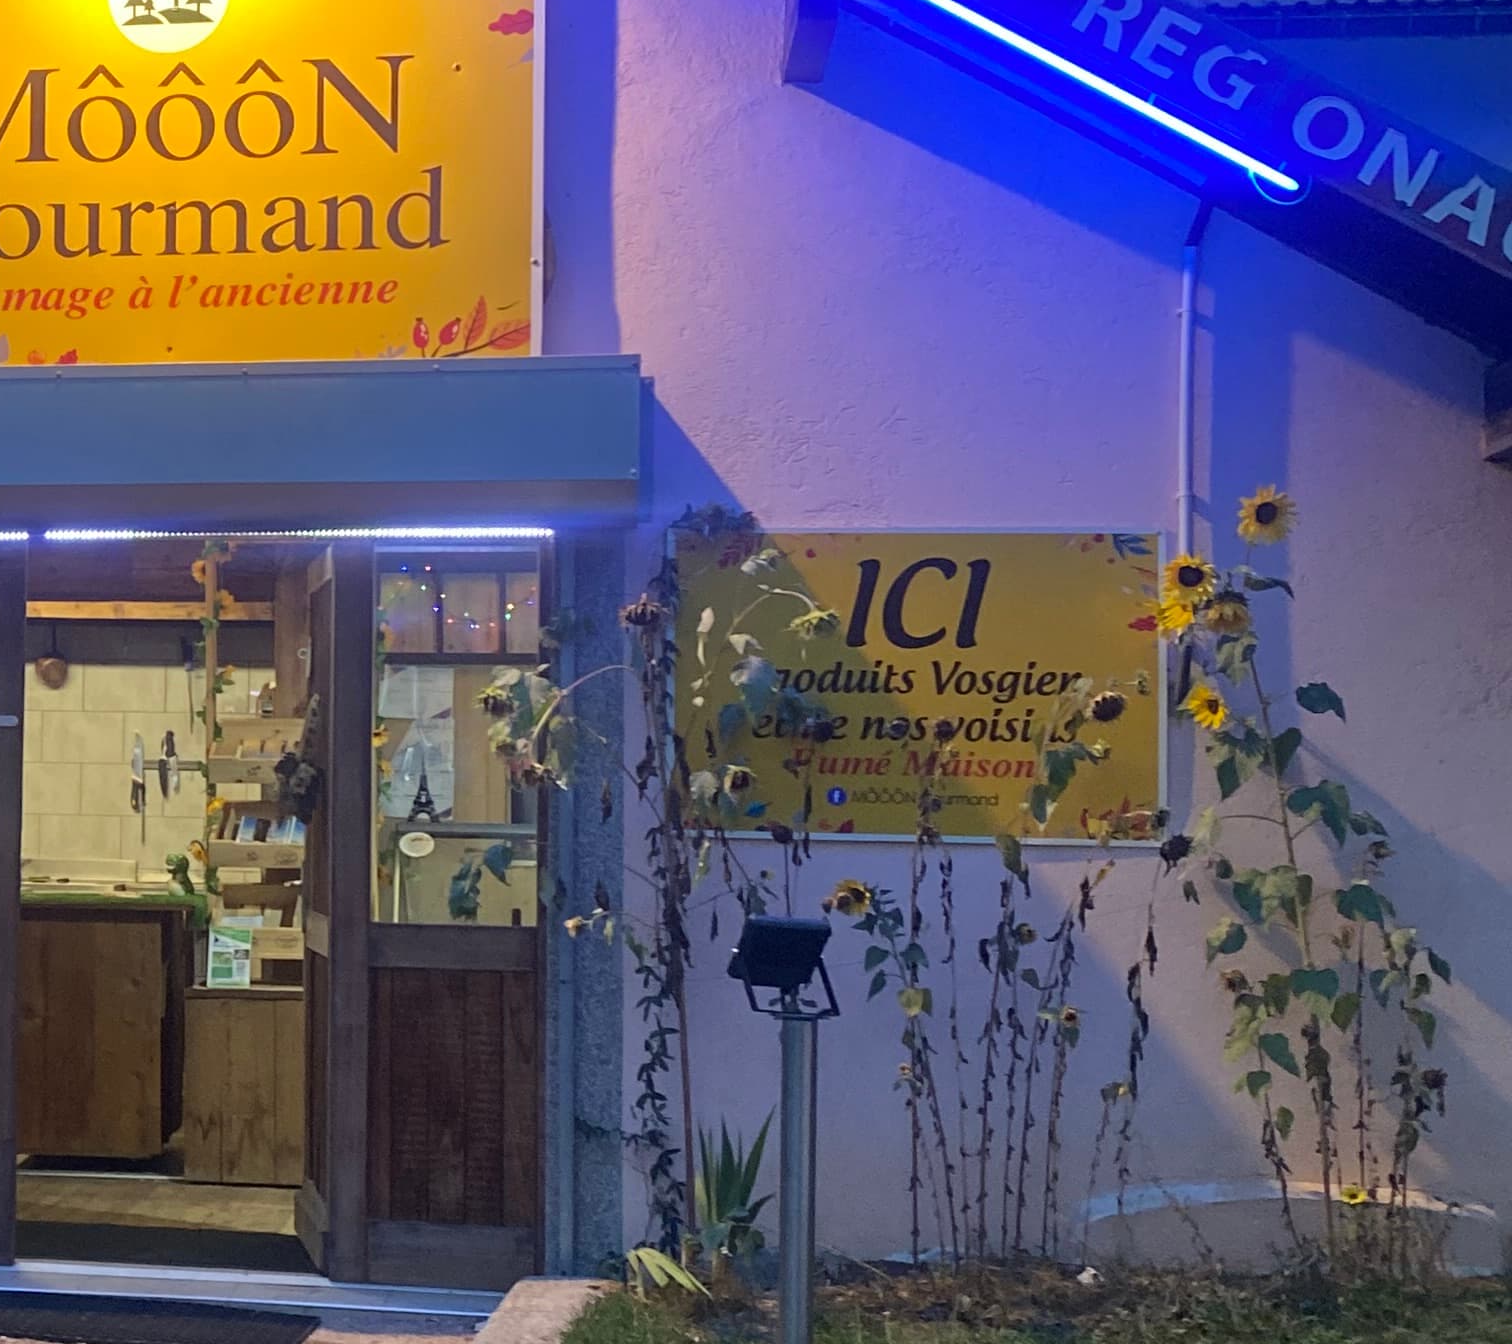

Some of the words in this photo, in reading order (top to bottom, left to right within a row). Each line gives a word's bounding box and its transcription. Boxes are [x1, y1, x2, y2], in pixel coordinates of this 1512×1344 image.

[128, 275, 155, 311] à
[168, 274, 400, 312] l'ancienne
[846, 557, 992, 650] ICI
[931, 659, 1088, 704] Vosgier
[935, 708, 1078, 744] voisis
[903, 749, 1036, 779] Maison
